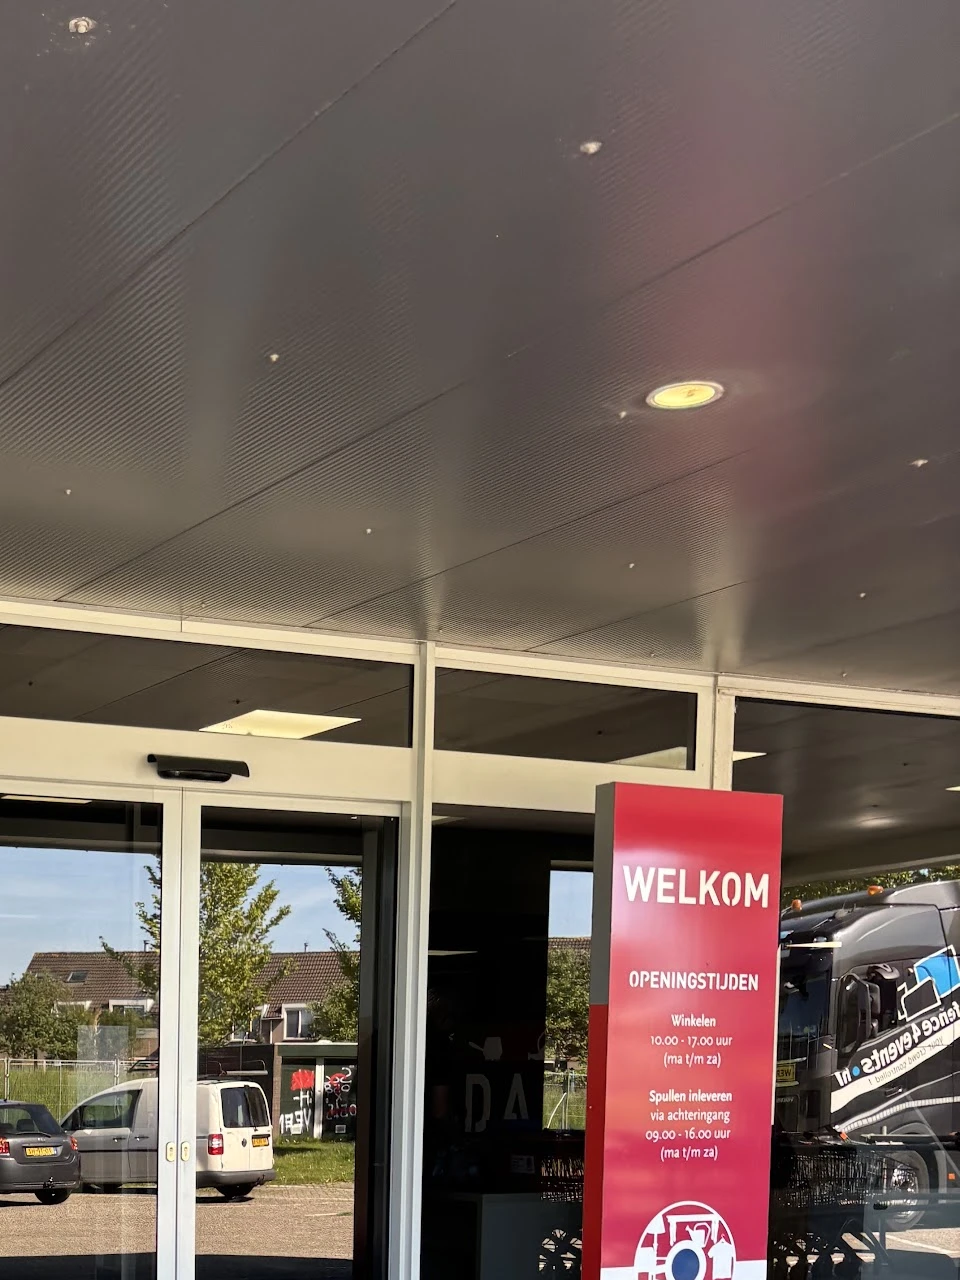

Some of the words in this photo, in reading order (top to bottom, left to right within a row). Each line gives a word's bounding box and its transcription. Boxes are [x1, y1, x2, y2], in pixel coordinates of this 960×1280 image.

[622, 865, 770, 909] WELKOM
[629, 970, 759, 991] OPENINGSTIJDEN
[671, 1014, 717, 1027] Winkelen
[650, 1035, 679, 1046] 10.00
[687, 1036, 714, 1048] 17.00
[716, 1036, 733, 1046] uur
[663, 1052, 683, 1068] (ma
[685, 1052, 704, 1068] t/m
[706, 1053, 722, 1068] za)
[649, 1089, 686, 1105] Spullen
[689, 1089, 733, 1102] inleveren
[650, 1109, 665, 1121] via
[667, 1108, 731, 1124] achteringang
[645, 1130, 676, 1143] 09.00
[684, 1127, 712, 1139] 16.00
[714, 1129, 732, 1139] uur
[660, 1146, 680, 1162] (ma
[682, 1146, 701, 1161] t/m
[703, 1145, 718, 1161] za)
